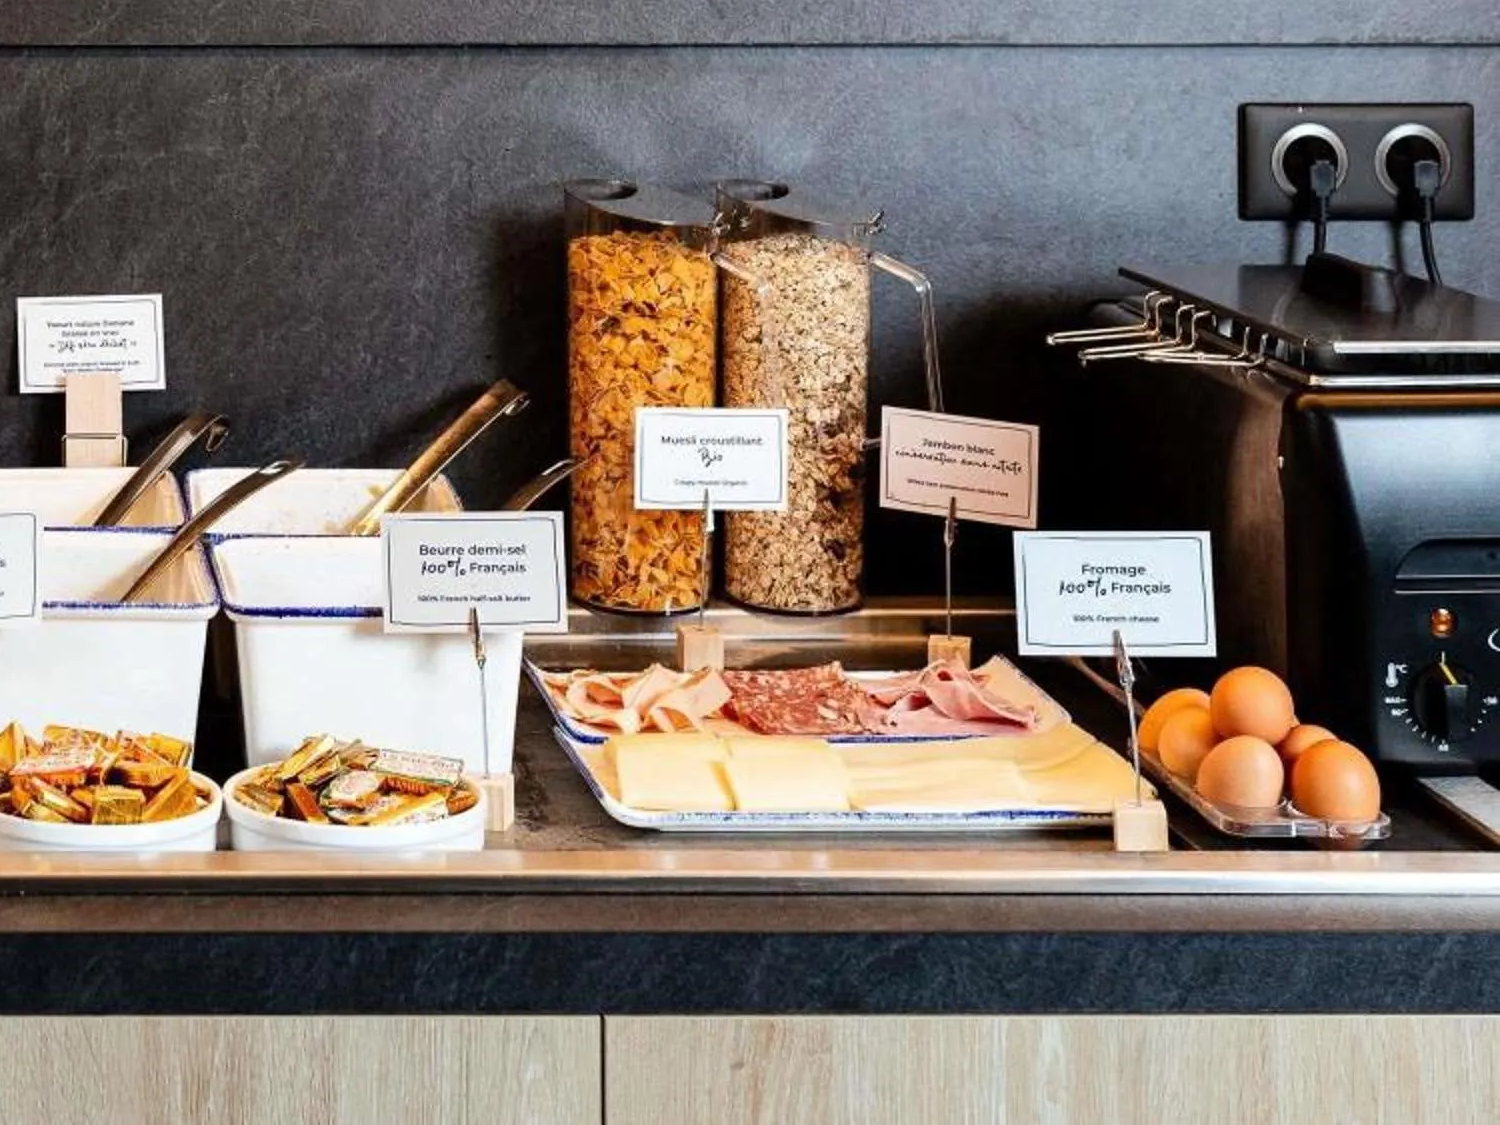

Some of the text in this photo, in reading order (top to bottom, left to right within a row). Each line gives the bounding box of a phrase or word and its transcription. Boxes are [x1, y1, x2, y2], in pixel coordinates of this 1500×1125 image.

[700, 436, 764, 446] croustillant
[921, 438, 996, 456] Jambon blanc
[697, 447, 724, 468] Bio
[419, 544, 527, 556] Beurre demi-sel
[421, 557, 527, 577] 100% Français
[1081, 564, 1147, 577] Fromage
[1059, 577, 1172, 597] 100% Français
